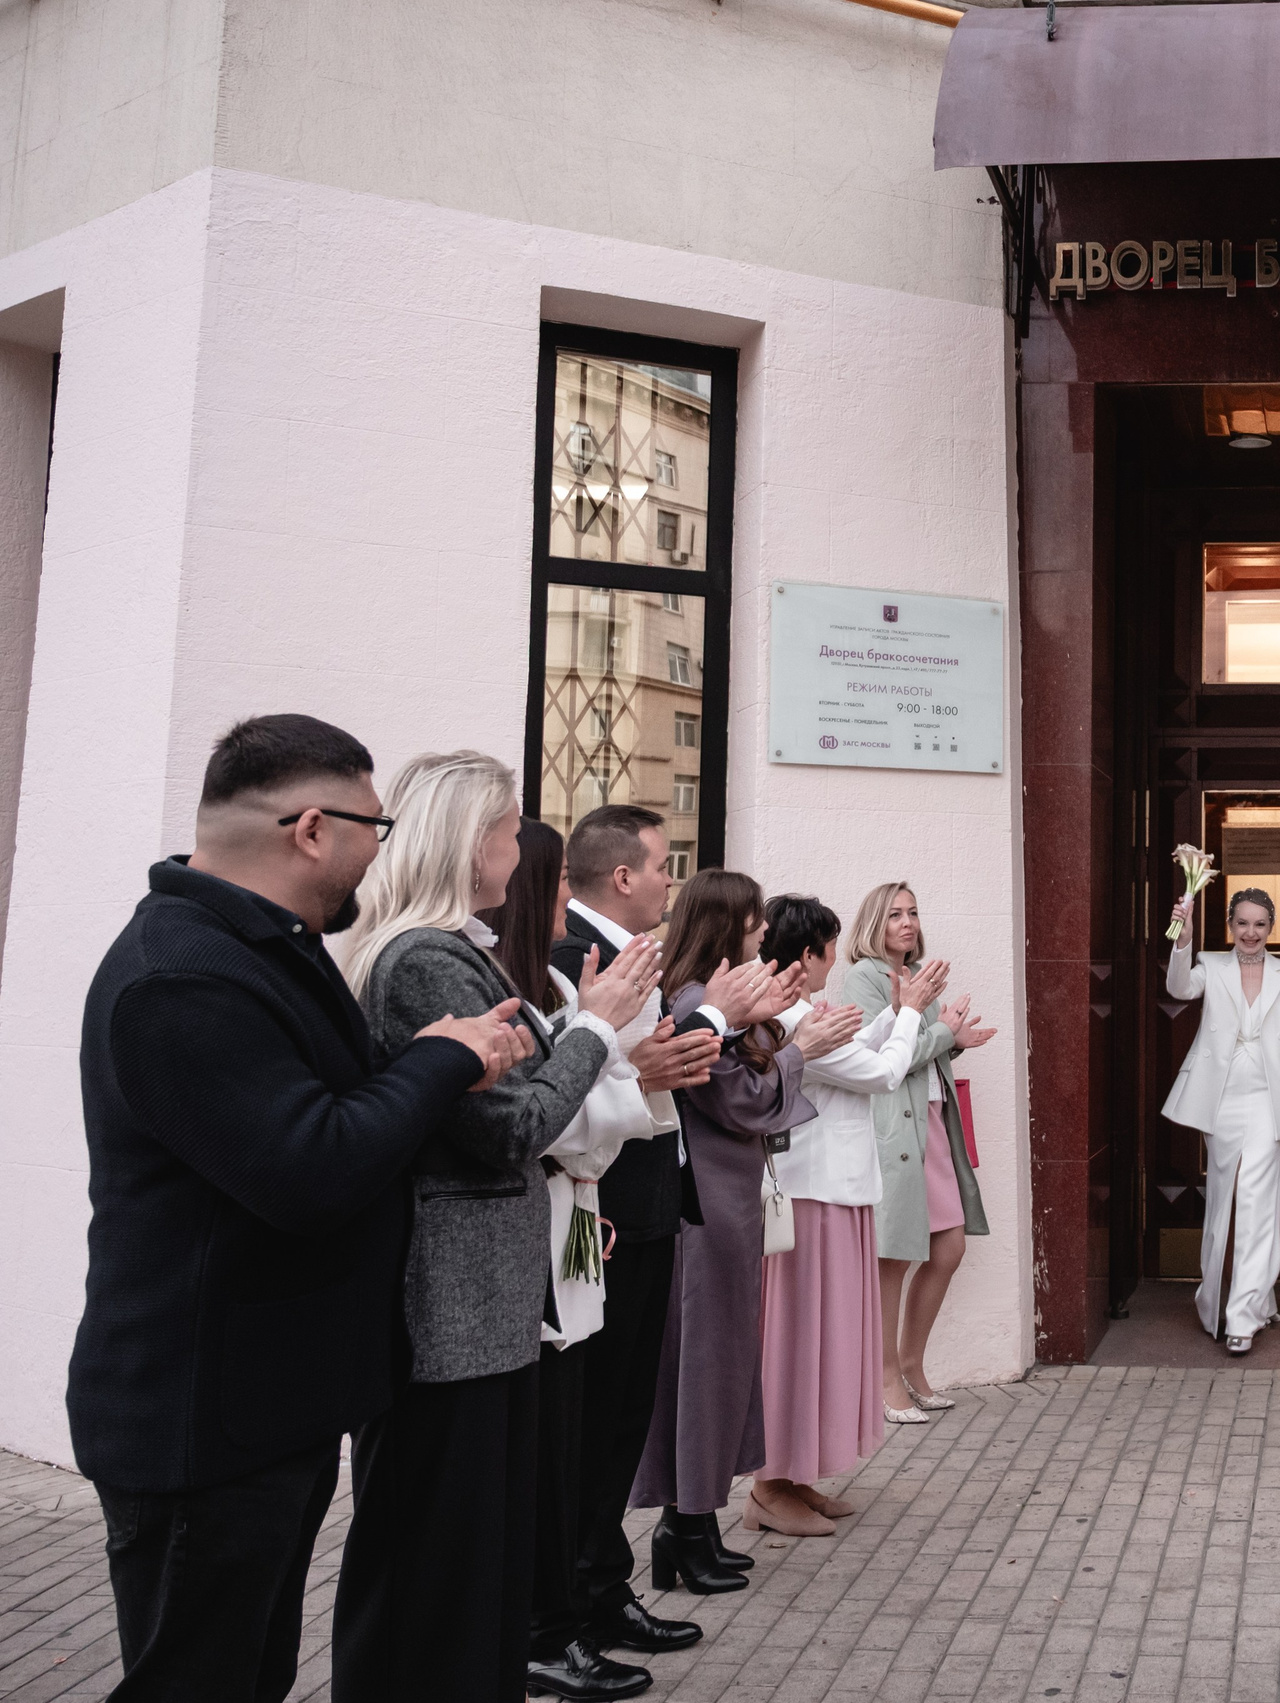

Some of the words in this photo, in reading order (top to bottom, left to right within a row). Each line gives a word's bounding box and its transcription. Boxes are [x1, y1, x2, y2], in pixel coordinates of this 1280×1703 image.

[1049, 239, 1236, 300] ДВОРЕЦ
[819, 644, 865, 660] Дворец
[866, 648, 959, 666] бракосочетания
[846, 681, 888, 694] РЕЖИМ
[890, 685, 933, 697] РАБОТЫ
[896, 702, 921, 714] 9:00
[931, 704, 959, 716] 18:00
[842, 740, 859, 748] ЗАГС
[860, 741, 891, 749] МОСКВЫ
